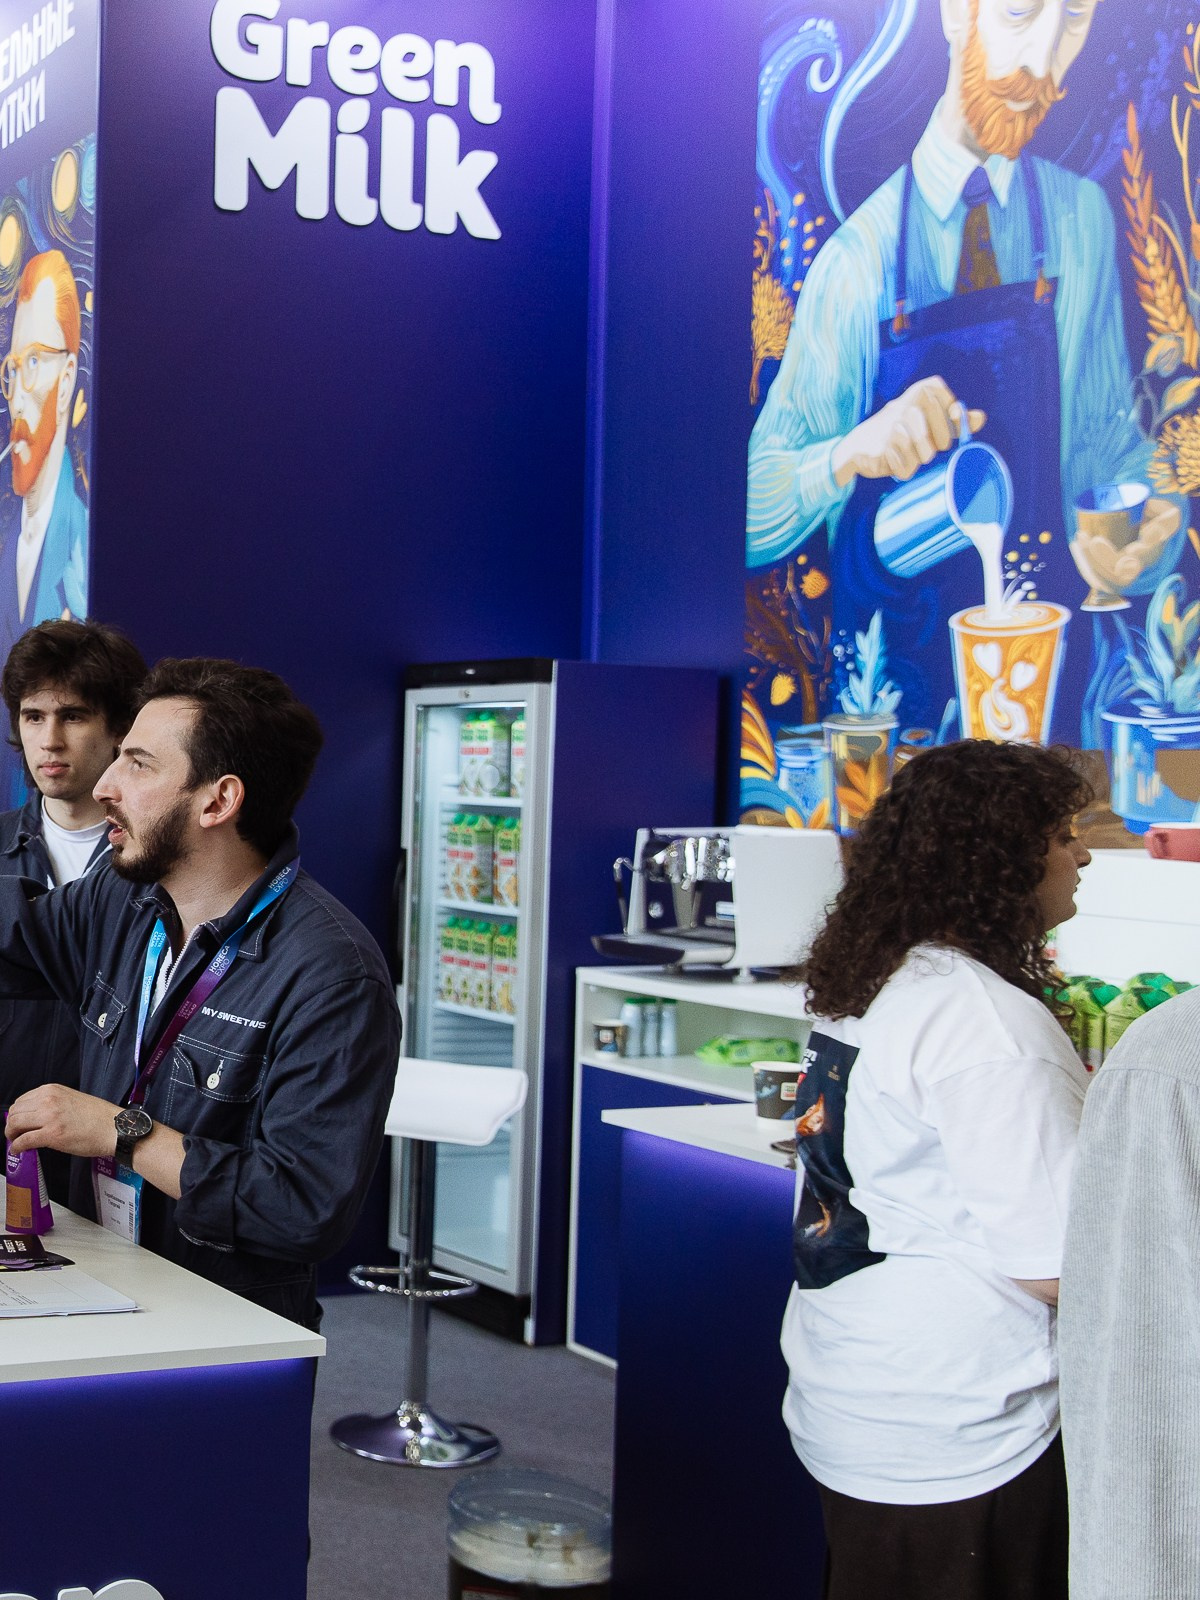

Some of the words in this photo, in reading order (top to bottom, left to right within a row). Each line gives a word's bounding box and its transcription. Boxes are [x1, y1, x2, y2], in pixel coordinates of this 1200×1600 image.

[210, 0, 502, 125] Green
[213, 86, 502, 240] Milk
[268, 866, 292, 889] HORECA
[273, 877, 288, 893] EXPO
[208, 945, 230, 973] HORECA
[215, 958, 230, 977] EXPO
[201, 1006, 218, 1017] MY
[217, 1011, 250, 1026] SWEET
[4, 1239, 16, 1253] SWEET
[15, 1240, 27, 1252] DUST
